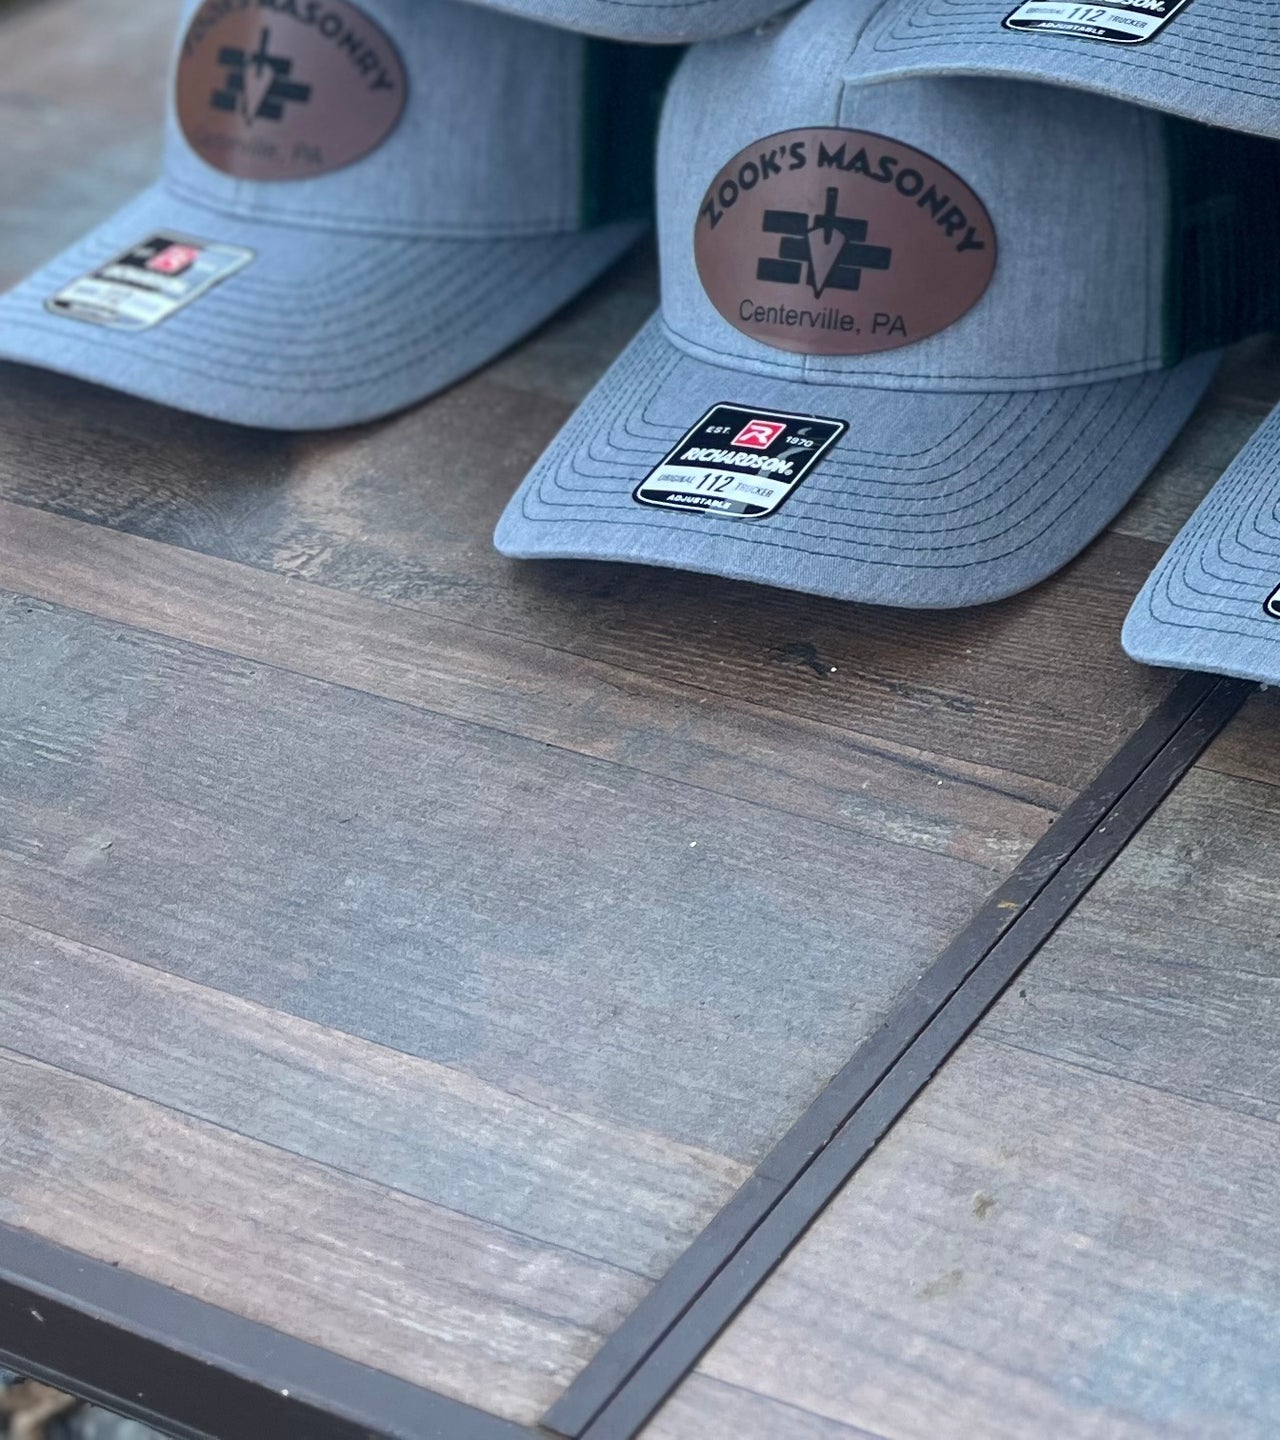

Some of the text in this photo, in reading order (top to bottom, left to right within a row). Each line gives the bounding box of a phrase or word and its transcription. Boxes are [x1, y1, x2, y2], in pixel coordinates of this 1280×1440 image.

[1068, 8, 1106, 22] 112
[701, 141, 984, 253] ZOOK'S MASONRY
[739, 299, 908, 337] Centerville, PA
[696, 473, 735, 493] 112
